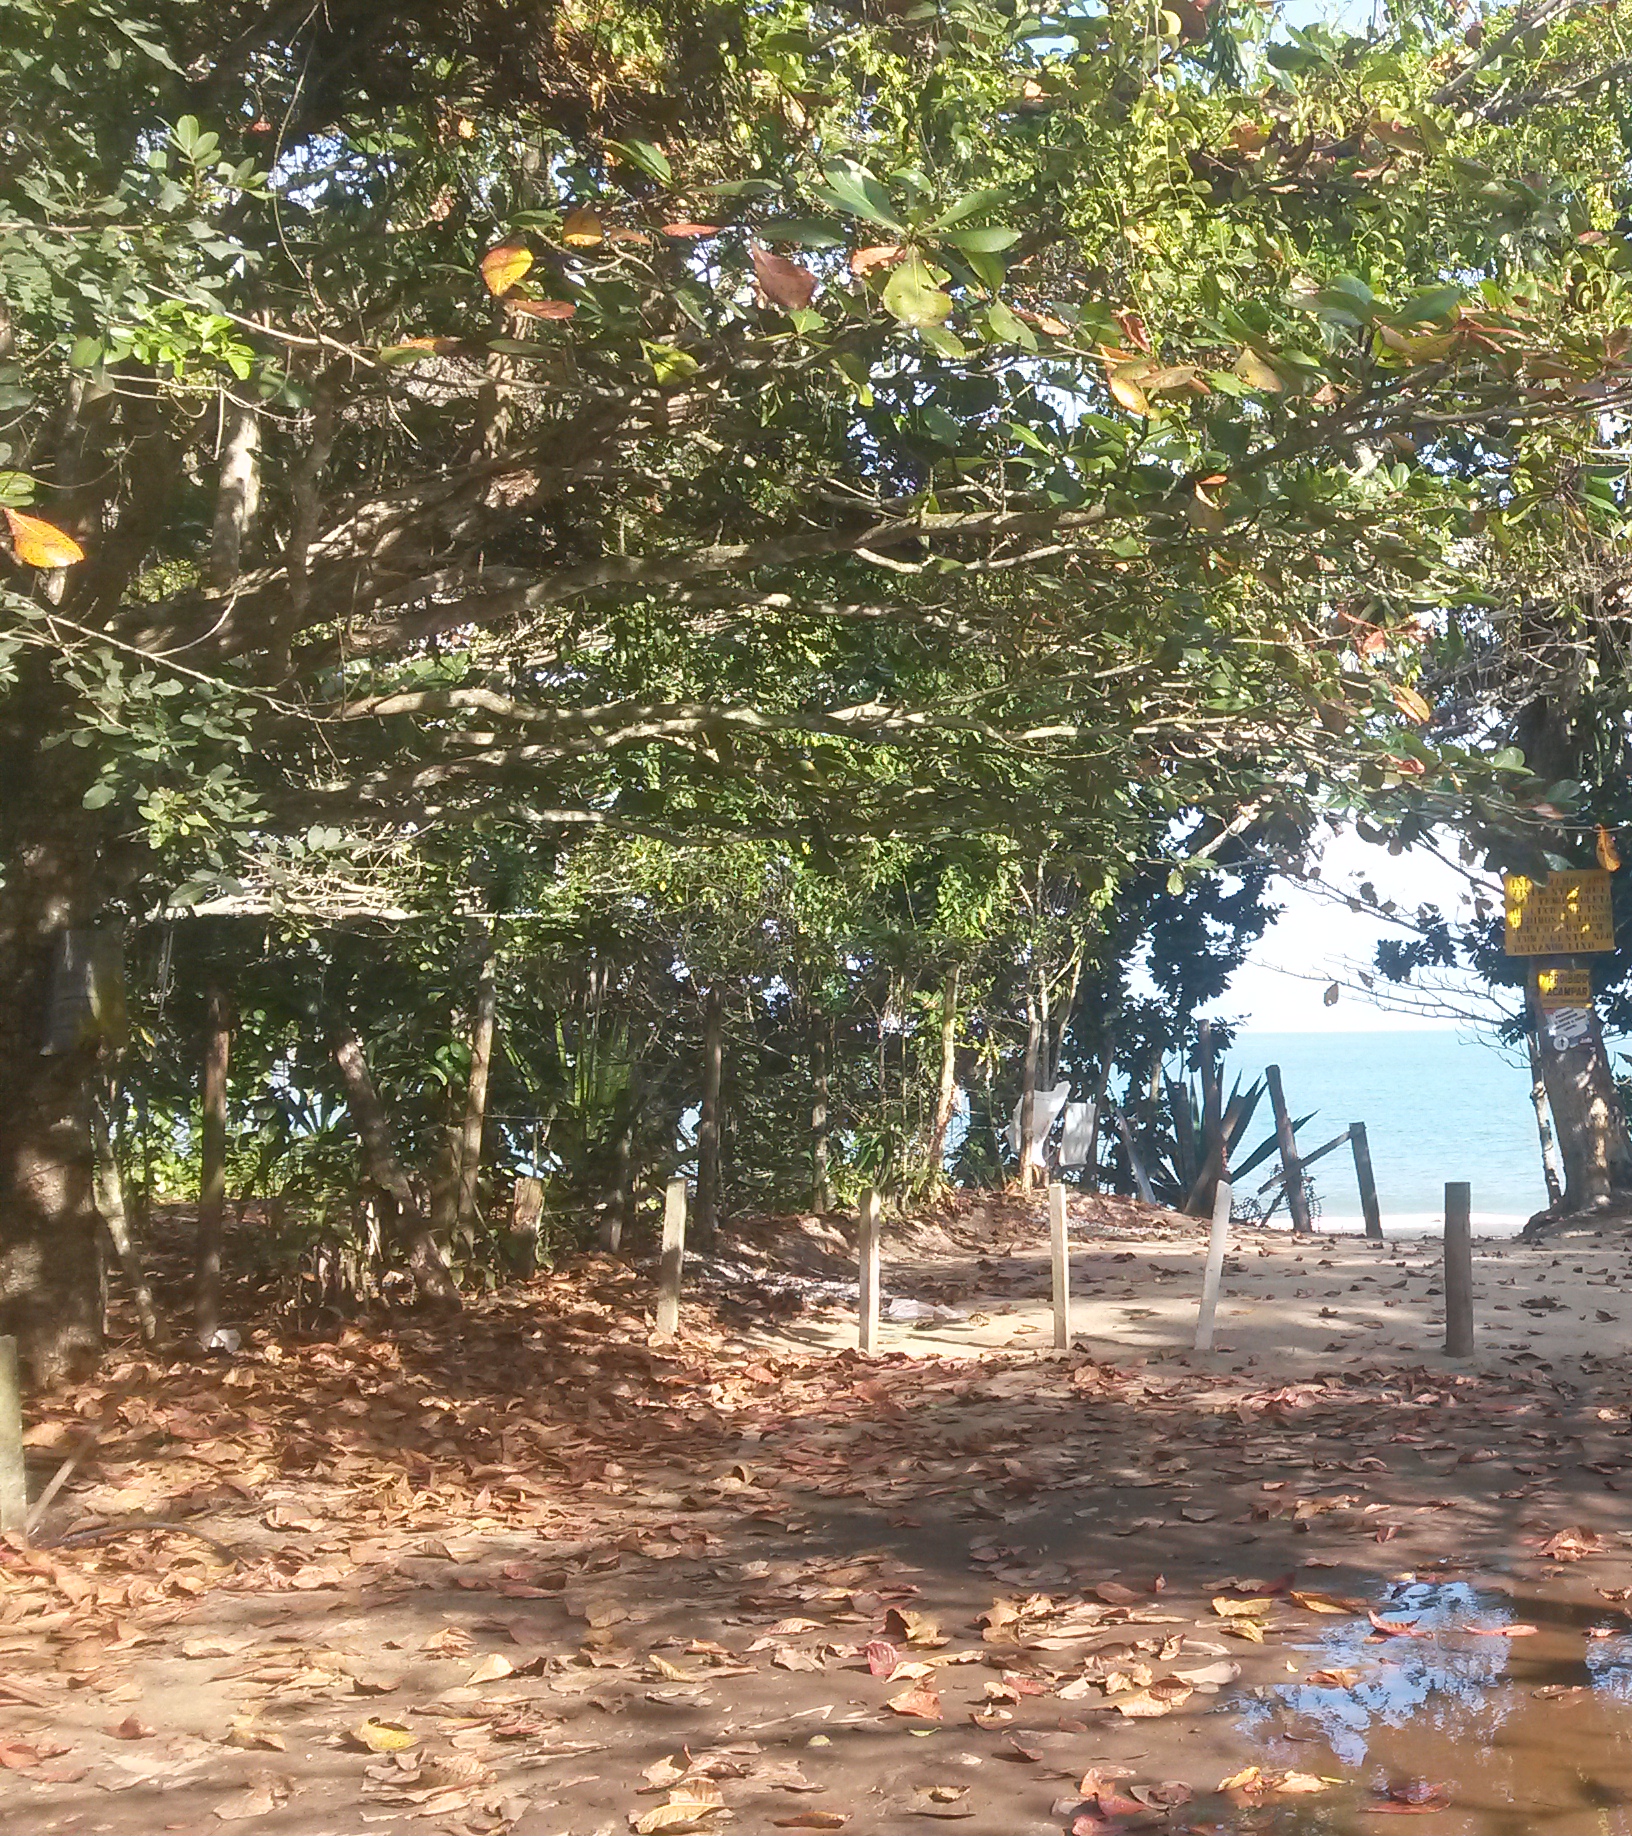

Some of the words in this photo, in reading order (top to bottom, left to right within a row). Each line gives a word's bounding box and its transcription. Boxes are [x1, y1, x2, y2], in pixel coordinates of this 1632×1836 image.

[1562, 904, 1582, 913] PR
[1536, 922, 1603, 933] COLABOEM
[1567, 941, 1595, 951] LIXO
[1548, 973, 1588, 984] PROIBIDO
[1546, 986, 1588, 996] ACAMPAR
